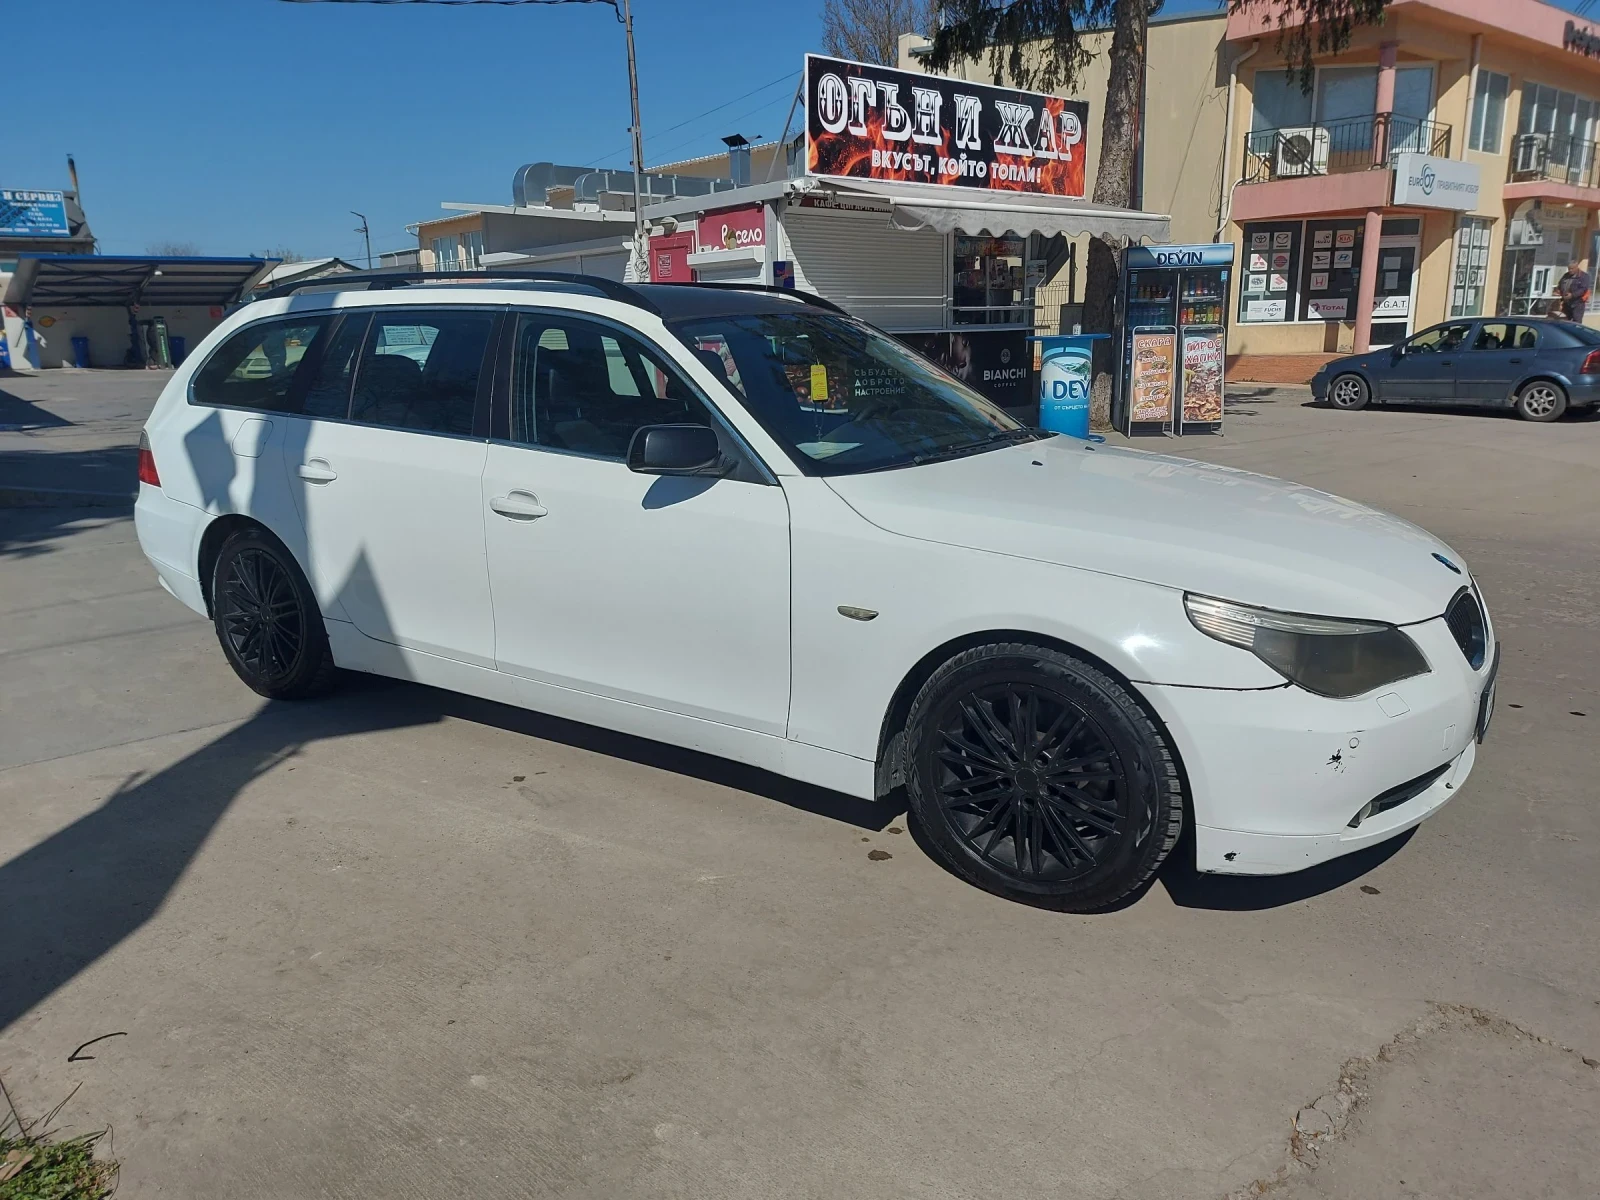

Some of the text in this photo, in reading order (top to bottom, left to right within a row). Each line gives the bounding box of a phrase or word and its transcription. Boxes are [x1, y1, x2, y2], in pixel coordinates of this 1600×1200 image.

[817, 72, 1082, 162] ОГЪН И ЖАР
[871, 149, 1042, 184] ВКУСЪТ, КОЙТО ТОПЛИ!
[1156, 250, 1203, 265] DEVIN
[1138, 337, 1172, 349] СКАРА
[983, 368, 1027, 381] BIANCHI
[854, 378, 905, 387] ДОБРОТО
[854, 386, 906, 397] НАСТРОЕНИЕ
